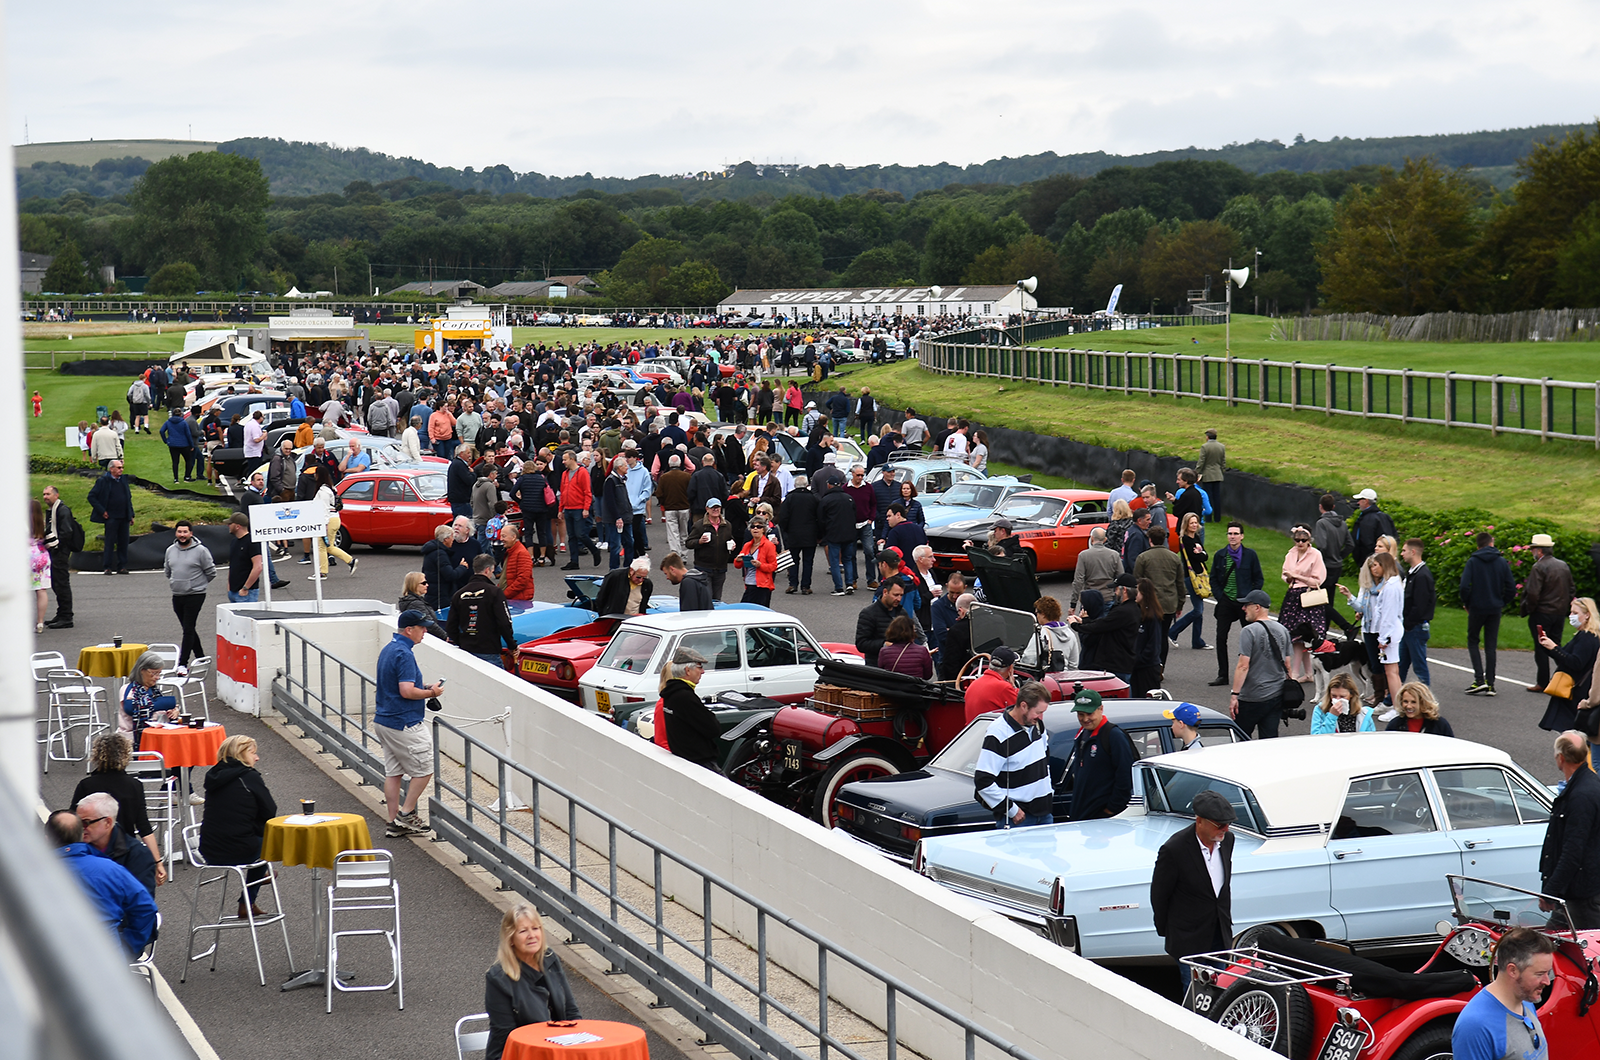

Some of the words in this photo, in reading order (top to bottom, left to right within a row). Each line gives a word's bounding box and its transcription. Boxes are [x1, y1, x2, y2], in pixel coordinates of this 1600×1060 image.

[761, 291, 852, 303] SUPER
[851, 287, 967, 302] SHELL
[442, 321, 483, 330] Coffee
[255, 526, 294, 536] MEETING
[295, 524, 322, 533] POINT
[524, 661, 535, 670] YLV
[786, 744, 797, 756] SV
[784, 757, 800, 770] 7143
[1195, 993, 1212, 1011] GB
[1332, 1028, 1360, 1050] SGU
